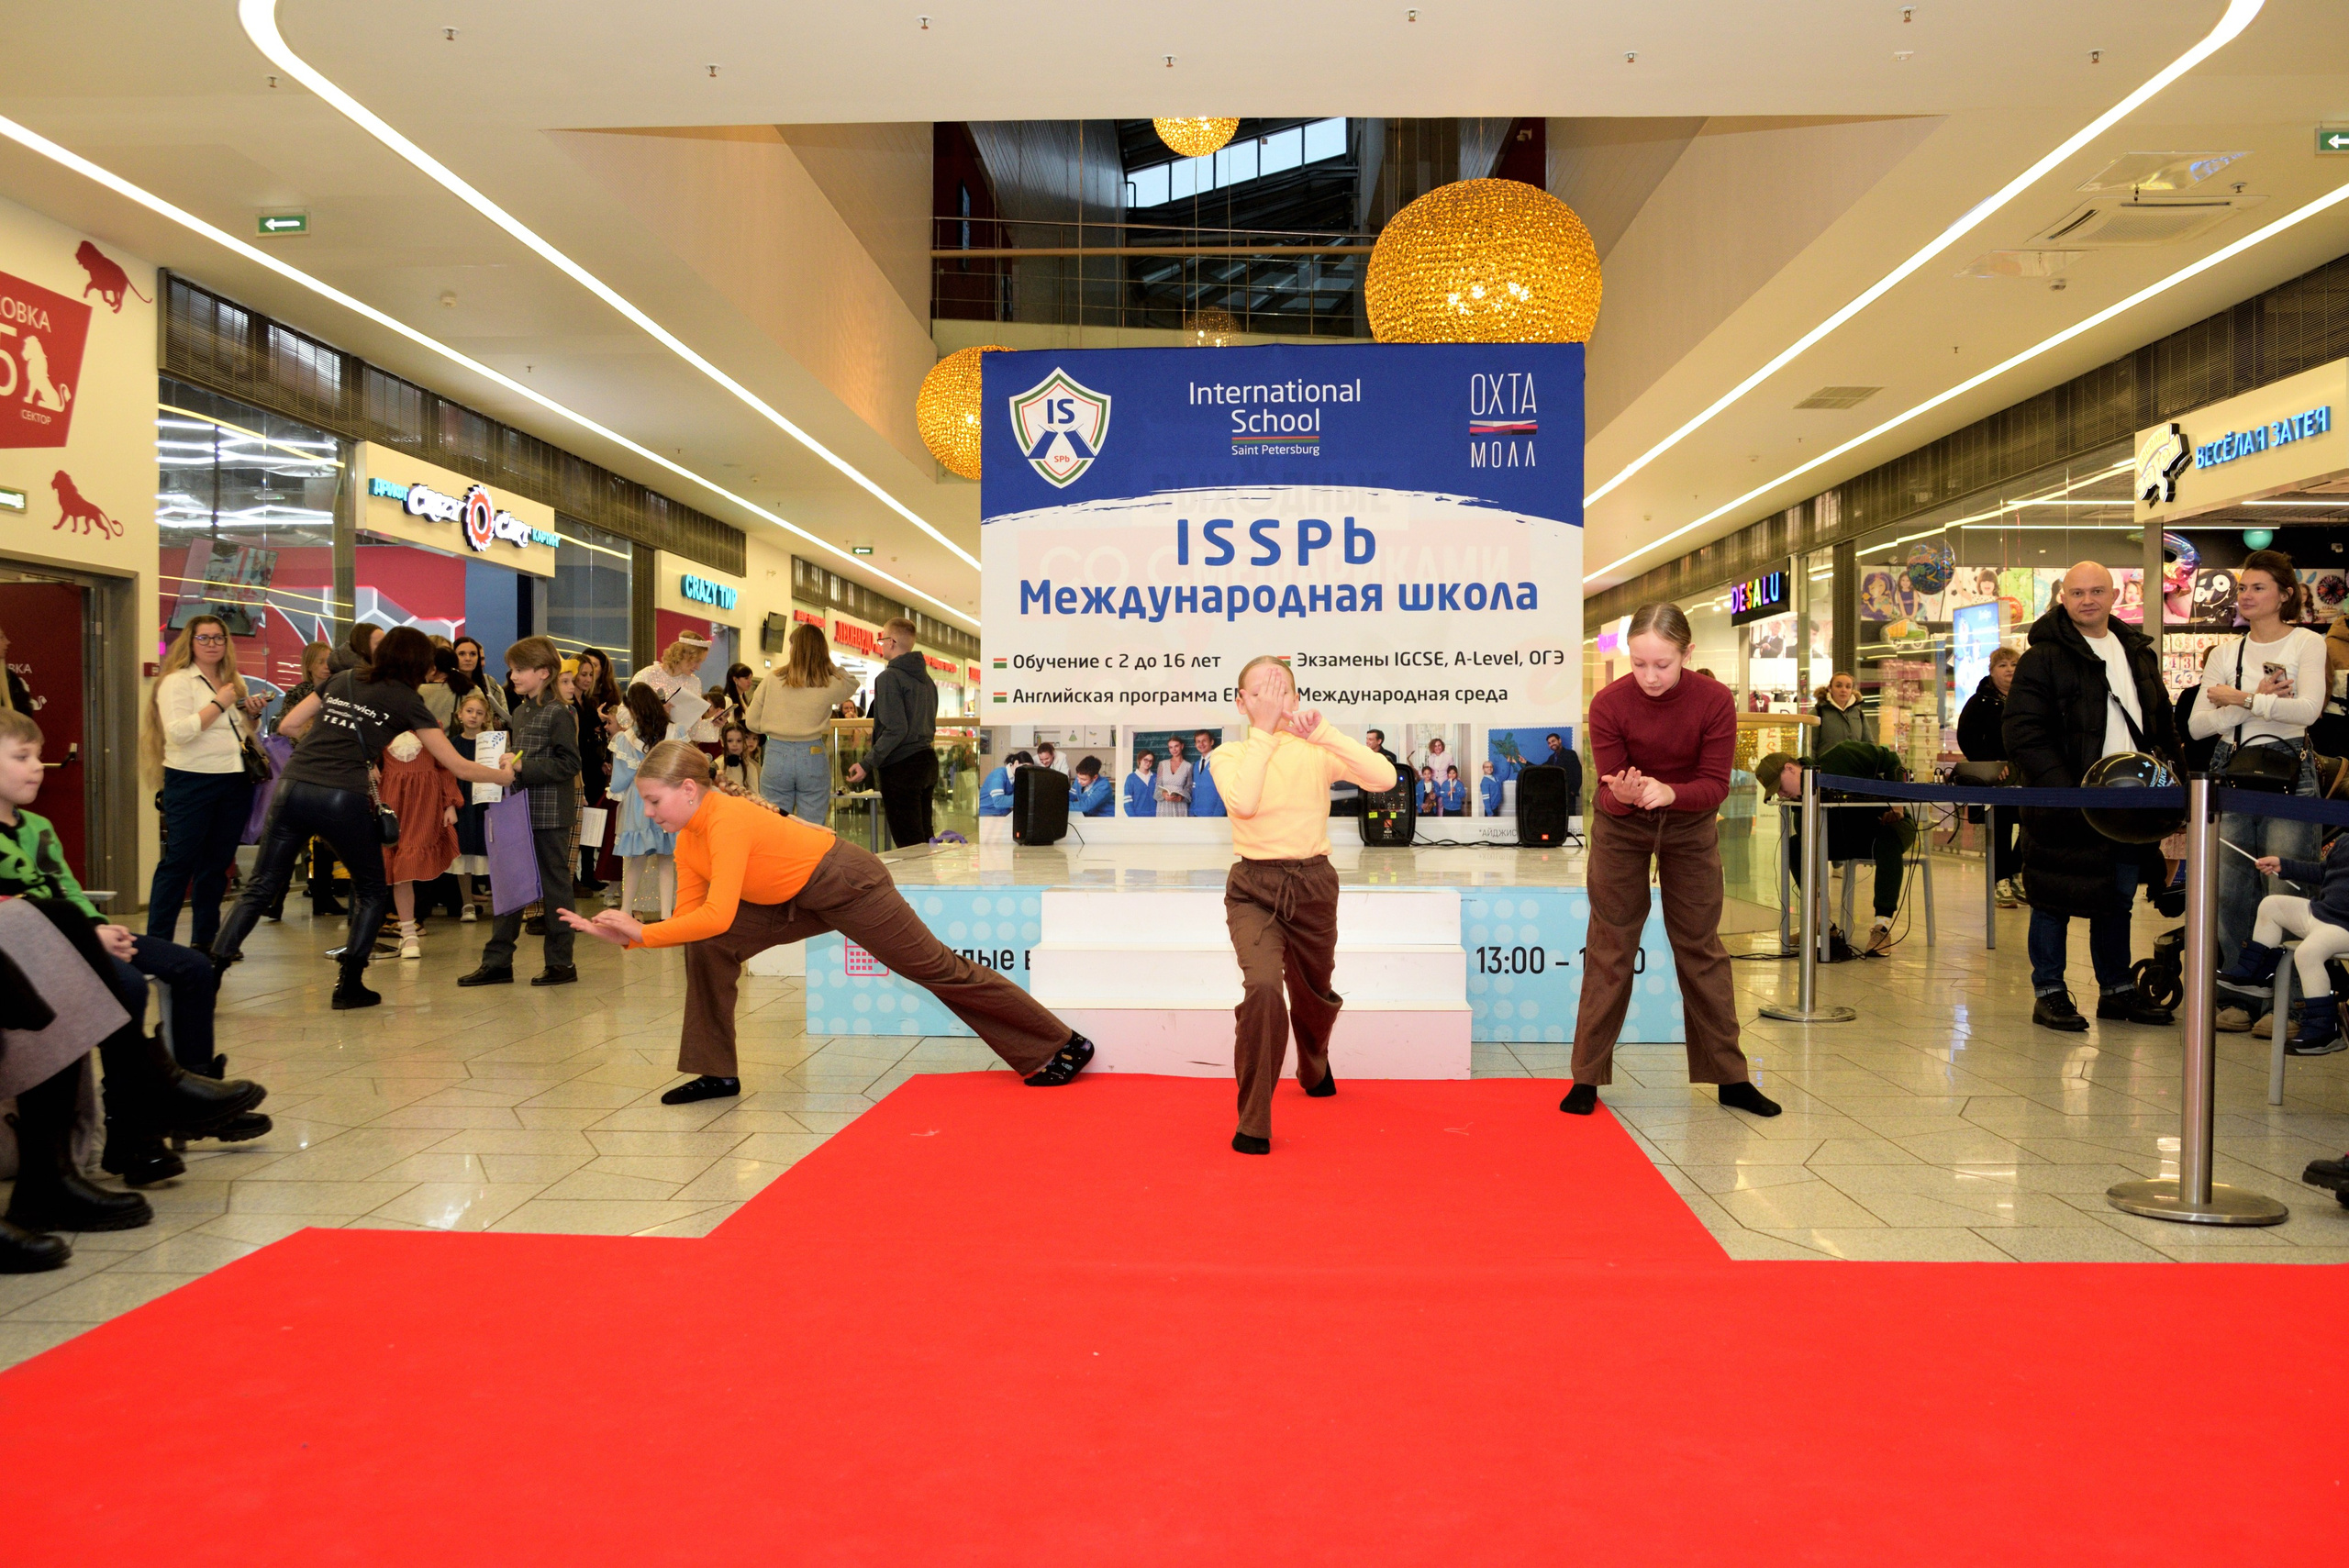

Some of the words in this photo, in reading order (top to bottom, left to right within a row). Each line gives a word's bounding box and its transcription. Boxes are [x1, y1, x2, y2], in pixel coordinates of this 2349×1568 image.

[0, 295, 51, 333] ОВКА
[1189, 378, 1361, 406] International
[1471, 373, 1537, 416] ОХТА
[21, 409, 52, 425] СЕКТОР
[1047, 399, 1074, 424] IS
[1230, 408, 1320, 433] School
[1231, 445, 1259, 456] Saint
[1262, 444, 1320, 457] Petersburg
[2196, 426, 2268, 470] ВЕСЁЛАЯ
[2270, 406, 2331, 448] ЗАТЕЯ
[1053, 455, 1071, 463] SPb
[1471, 440, 1536, 468] МОЛЛ
[1177, 517, 1375, 566] ISSPb
[683, 573, 718, 606] CRAZY
[718, 584, 738, 610] ТИР
[1020, 579, 1382, 623] Международная
[1398, 582, 1538, 611] школа
[1731, 571, 1780, 615] DESALU
[835, 621, 874, 655] ЛЕОНАРДО
[1013, 654, 1099, 673] Обучение
[1105, 657, 1113, 668] с
[1119, 654, 1129, 668] 2
[1134, 656, 1157, 671] до
[1163, 653, 1186, 668] 16
[1191, 656, 1221, 668] лет
[1297, 652, 1388, 667] Экзамены
[1395, 651, 1448, 668] IGCSE,
[1454, 651, 1523, 667] A-Level,
[1529, 650, 1564, 665] ОГЭ
[1012, 687, 1114, 704] Английская
[1119, 691, 1217, 706] программа
[1297, 687, 1449, 705] Международная
[1455, 689, 1508, 705] среда
[1476, 946, 1545, 974] 13:00
